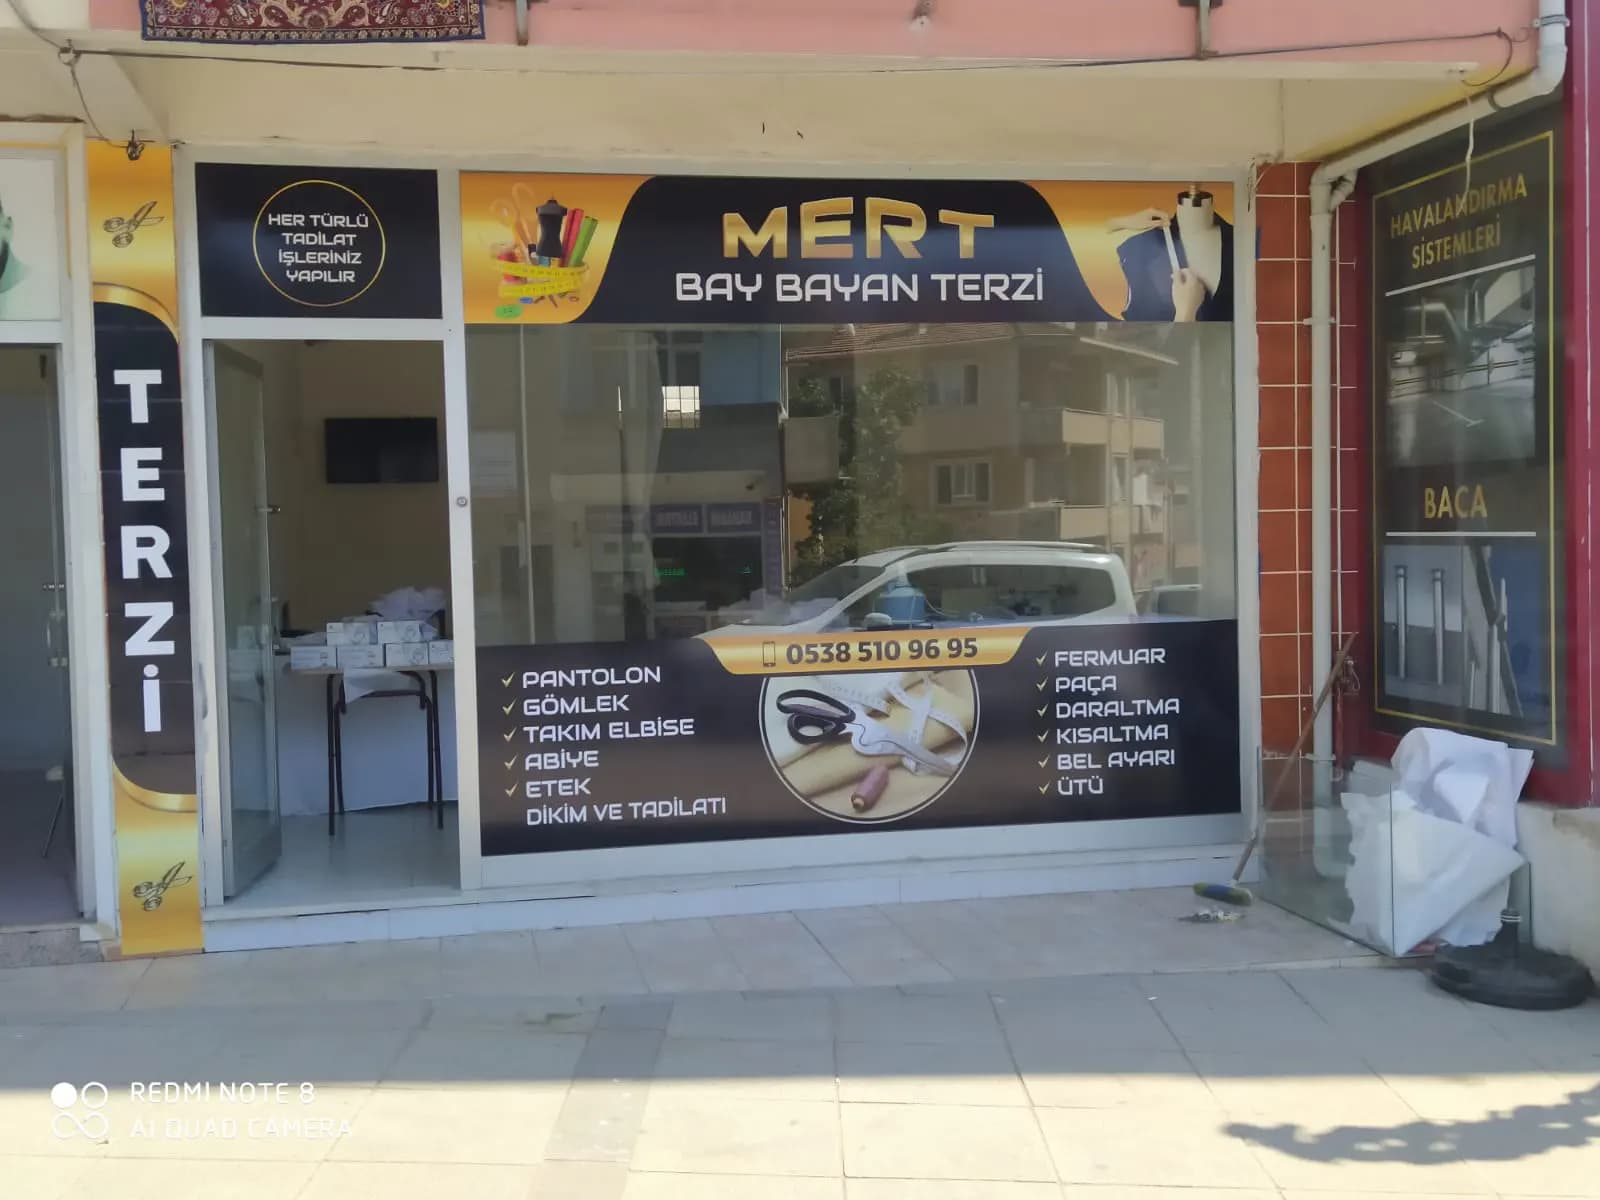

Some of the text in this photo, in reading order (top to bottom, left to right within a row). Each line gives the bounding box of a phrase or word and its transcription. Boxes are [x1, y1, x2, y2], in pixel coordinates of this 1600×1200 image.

[1391, 172, 1527, 239] HAVALANDIRMA
[268, 213, 368, 227] HER TÜRLÜ
[723, 197, 994, 258] MERT
[282, 231, 357, 246] TADİLAT
[1412, 213, 1500, 269] SİSTEMLERİ
[279, 249, 362, 266] İŞLERİNİZ
[286, 270, 355, 282] YAPILIR
[676, 267, 1043, 302] BAY BAYAN TERZİ
[1424, 484, 1488, 519] BACA
[786, 638, 978, 664] 0538 510 96 95
[1055, 648, 1166, 667] FERMUAR
[522, 666, 661, 688] PANTOLON
[1055, 675, 1117, 696] PAÇA
[523, 694, 629, 716] GÖMLEK
[1056, 698, 1180, 718] DARALTMA
[523, 717, 695, 743] TAKIM ELBİSE
[1056, 725, 1169, 744] KISALTMA
[525, 749, 599, 770] ABİYE
[1057, 749, 1175, 769] BEL AYARI
[526, 778, 591, 798] ETEK
[1058, 776, 1104, 795] ÜTÜ
[527, 796, 726, 825] DİKİM VE TADİLATI
